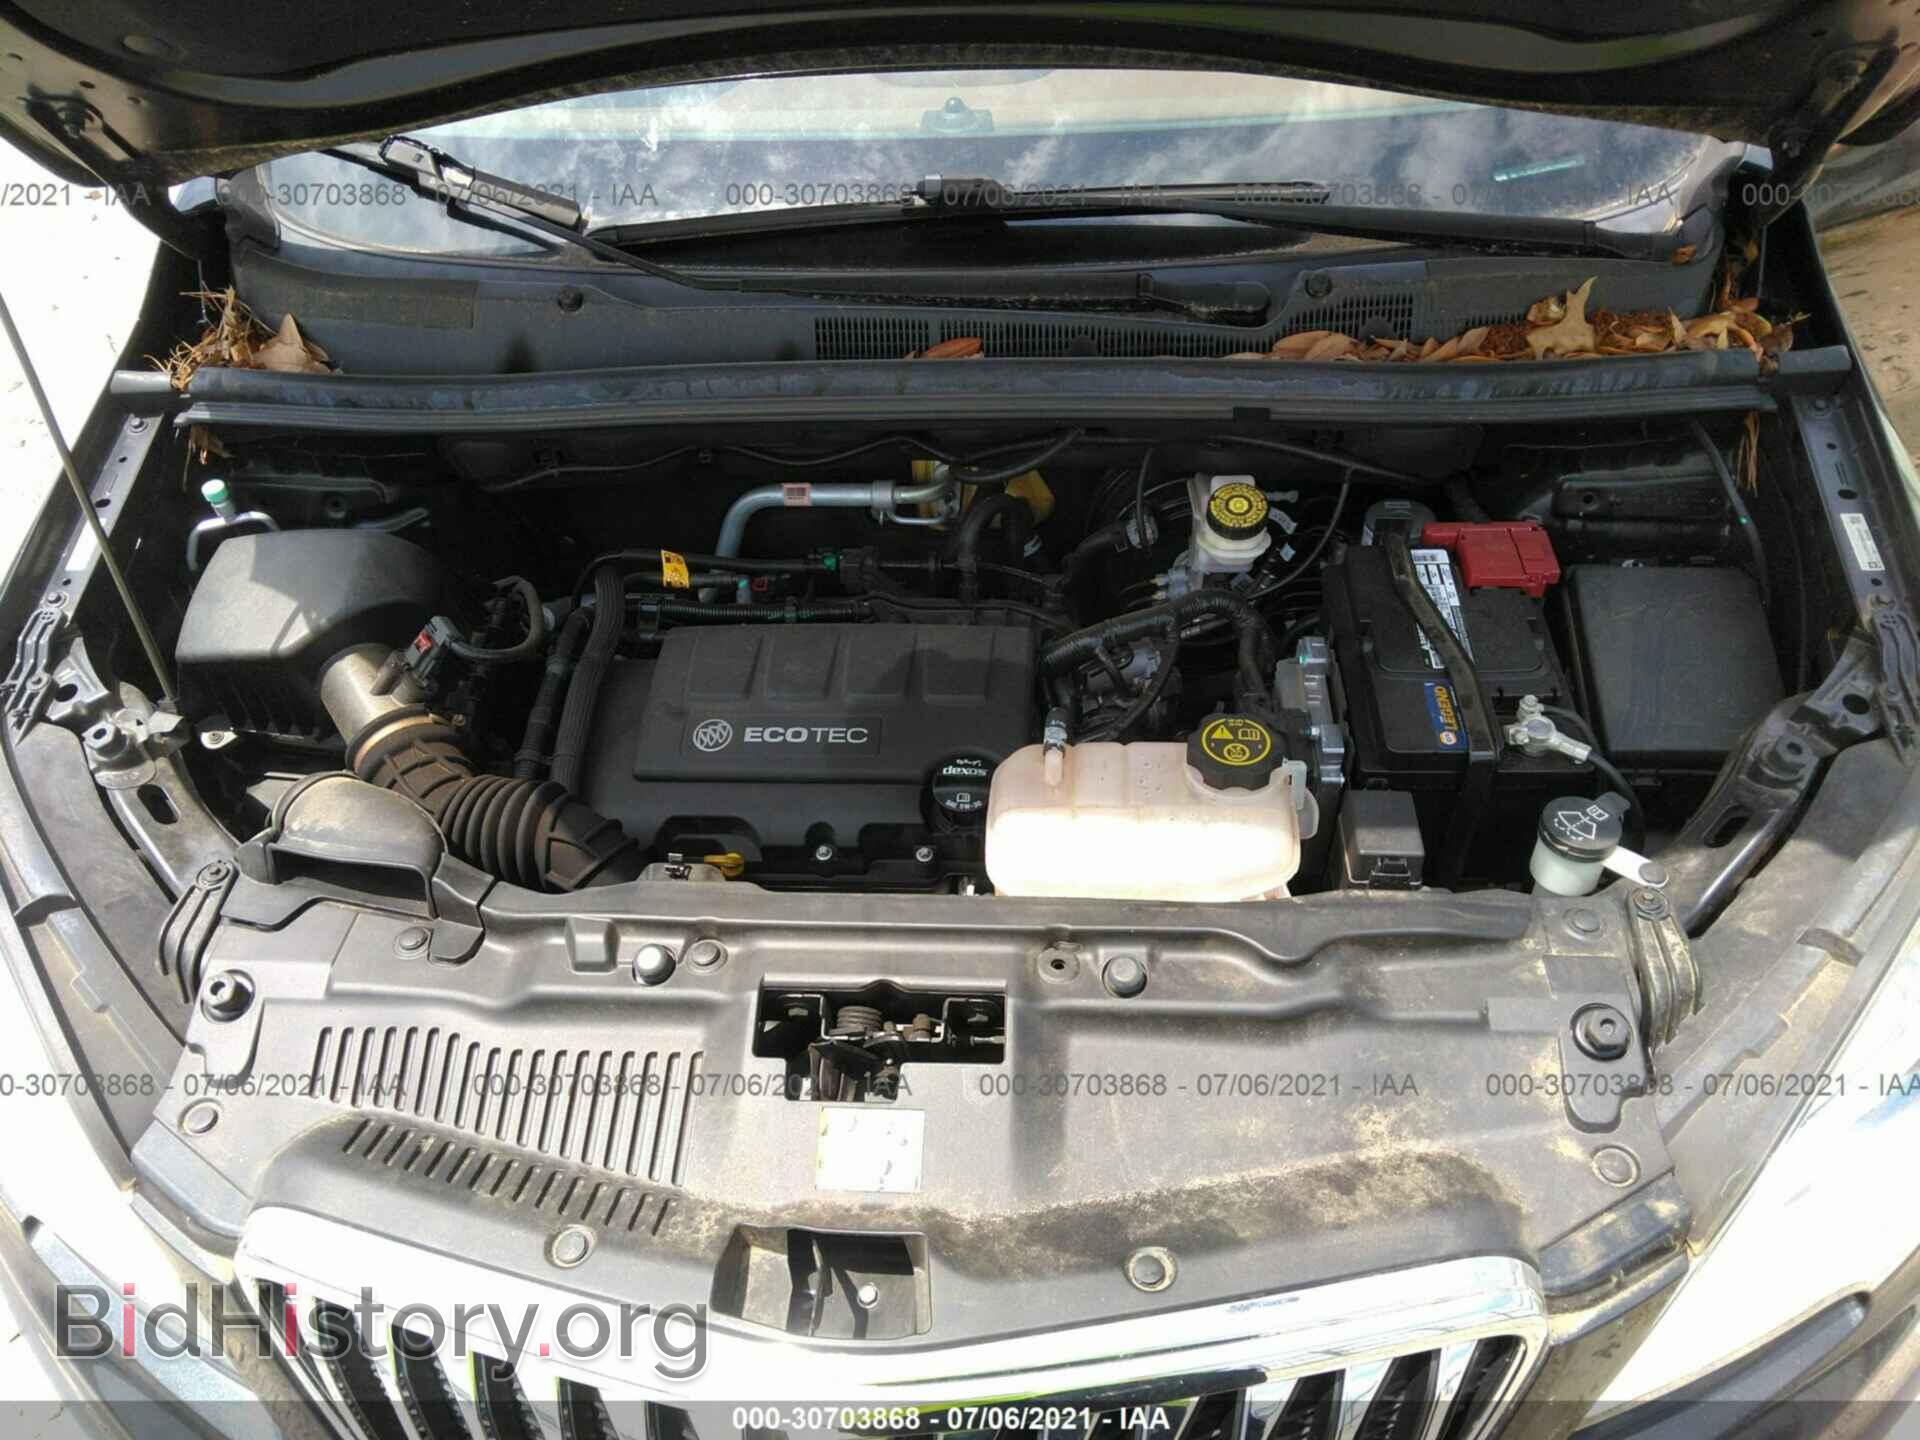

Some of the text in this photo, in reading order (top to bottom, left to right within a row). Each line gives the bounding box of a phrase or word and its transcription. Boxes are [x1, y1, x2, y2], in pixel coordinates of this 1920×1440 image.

[1434, 686, 1457, 731] LEGEND
[743, 726, 869, 744] ECOTEC
[942, 765, 987, 776] dexos
